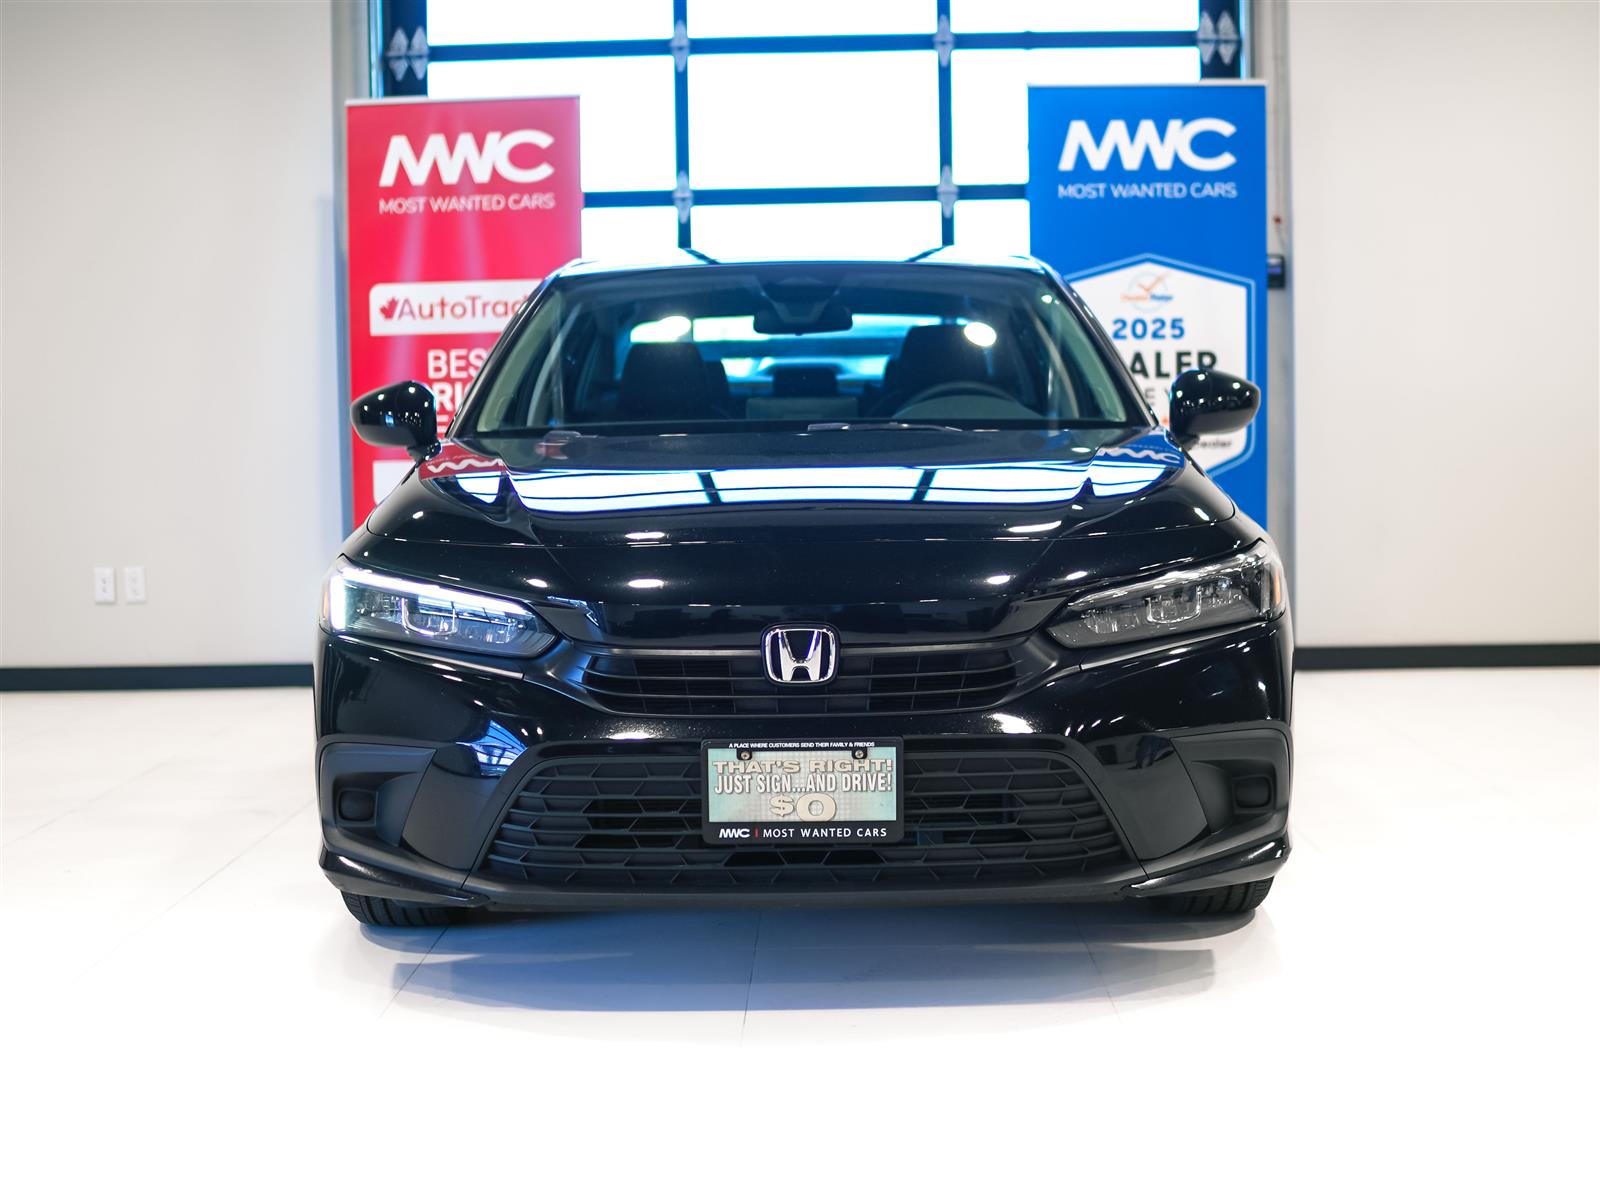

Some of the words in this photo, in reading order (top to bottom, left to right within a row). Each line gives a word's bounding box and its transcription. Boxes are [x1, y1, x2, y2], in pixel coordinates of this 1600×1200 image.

[1058, 117, 1237, 172] MWC
[378, 129, 555, 188] MWC
[1058, 183, 1106, 199] MOST
[1111, 183, 1187, 199] WANTED
[1190, 182, 1238, 198] CARS
[379, 197, 425, 215] MOST
[430, 194, 504, 213] WANTED
[508, 192, 555, 210] CARS
[1112, 318, 1185, 340] 2025
[712, 759, 801, 774] THAT'S
[808, 759, 893, 773] RIGHT!
[714, 774, 752, 794] JUST
[842, 772, 893, 792] DRIVE!
[718, 828, 751, 838] MWC
[762, 828, 795, 838] MOST
[800, 828, 852, 838] WANTED
[856, 827, 887, 837] CARS
